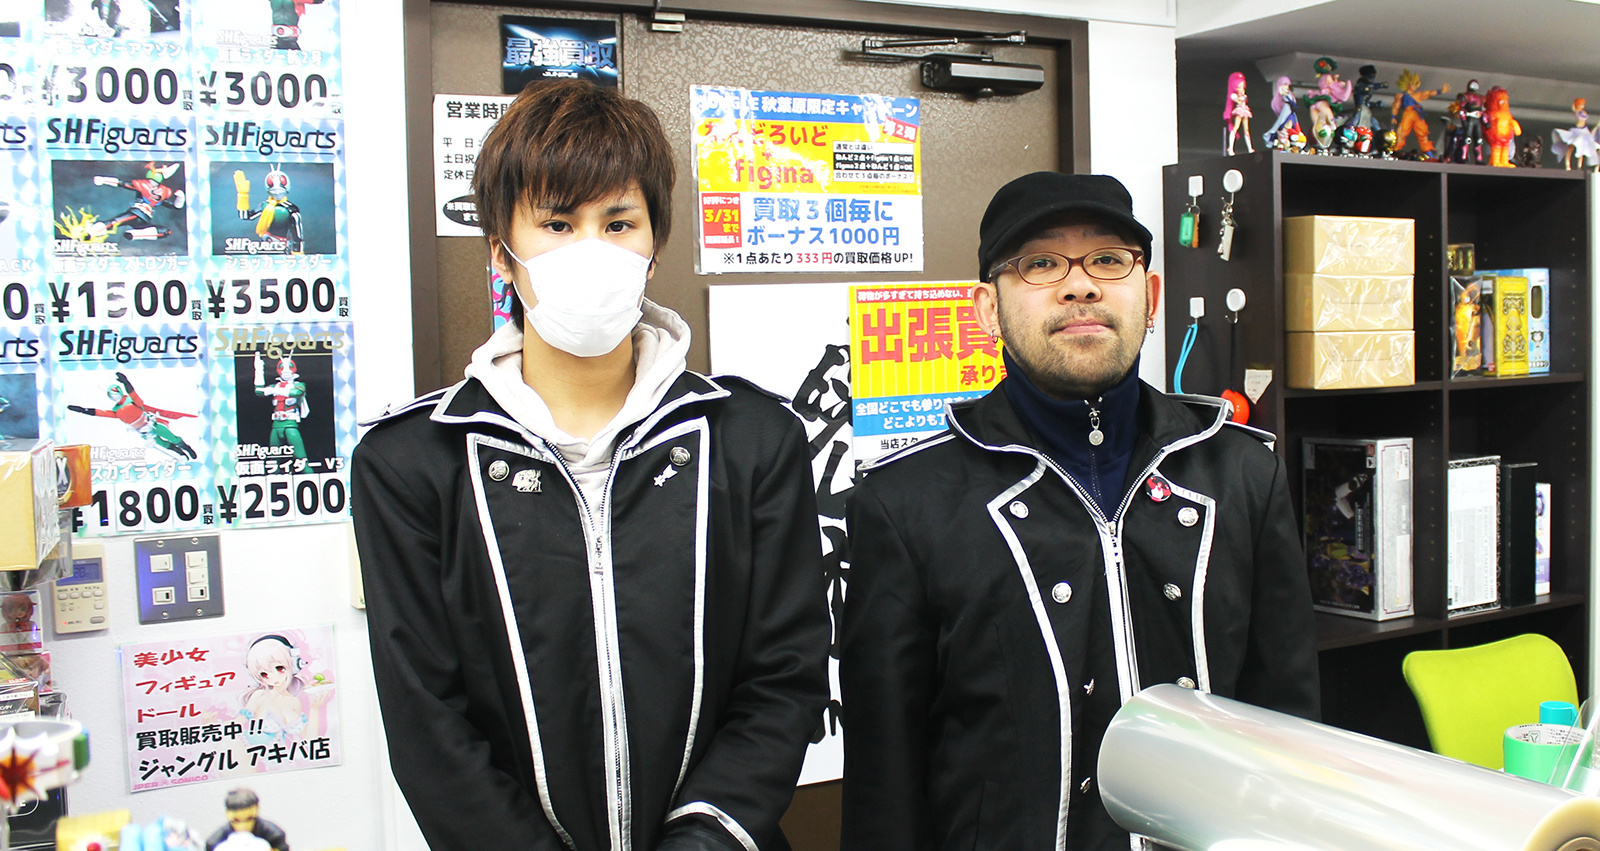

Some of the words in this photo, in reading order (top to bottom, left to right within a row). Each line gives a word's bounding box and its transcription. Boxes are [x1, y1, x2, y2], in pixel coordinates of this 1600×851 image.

[506, 37, 614, 69] 最強買取
[704, 122, 828, 147] どろいど
[443, 154, 475, 164] 土日祝
[704, 208, 740, 222] 3/31
[753, 197, 893, 223] 買取3個毎に
[722, 223, 740, 233] まで
[747, 226, 899, 246] ボーナス1000円
[48, 280, 187, 322] ¥1500
[205, 277, 335, 318] ¥3500
[339, 296, 349, 317] 買取
[191, 300, 202, 320] 買取
[235, 458, 322, 478] 仮面ライダー
[324, 457, 345, 471] V3
[217, 478, 346, 525] ¥2500
[203, 503, 214, 525] 買取
[133, 646, 210, 668] 美少女
[135, 671, 236, 695] フィギュア
[137, 703, 202, 723] ドール
[139, 749, 239, 780] ジャングル
[246, 737, 330, 767] アキバ店
